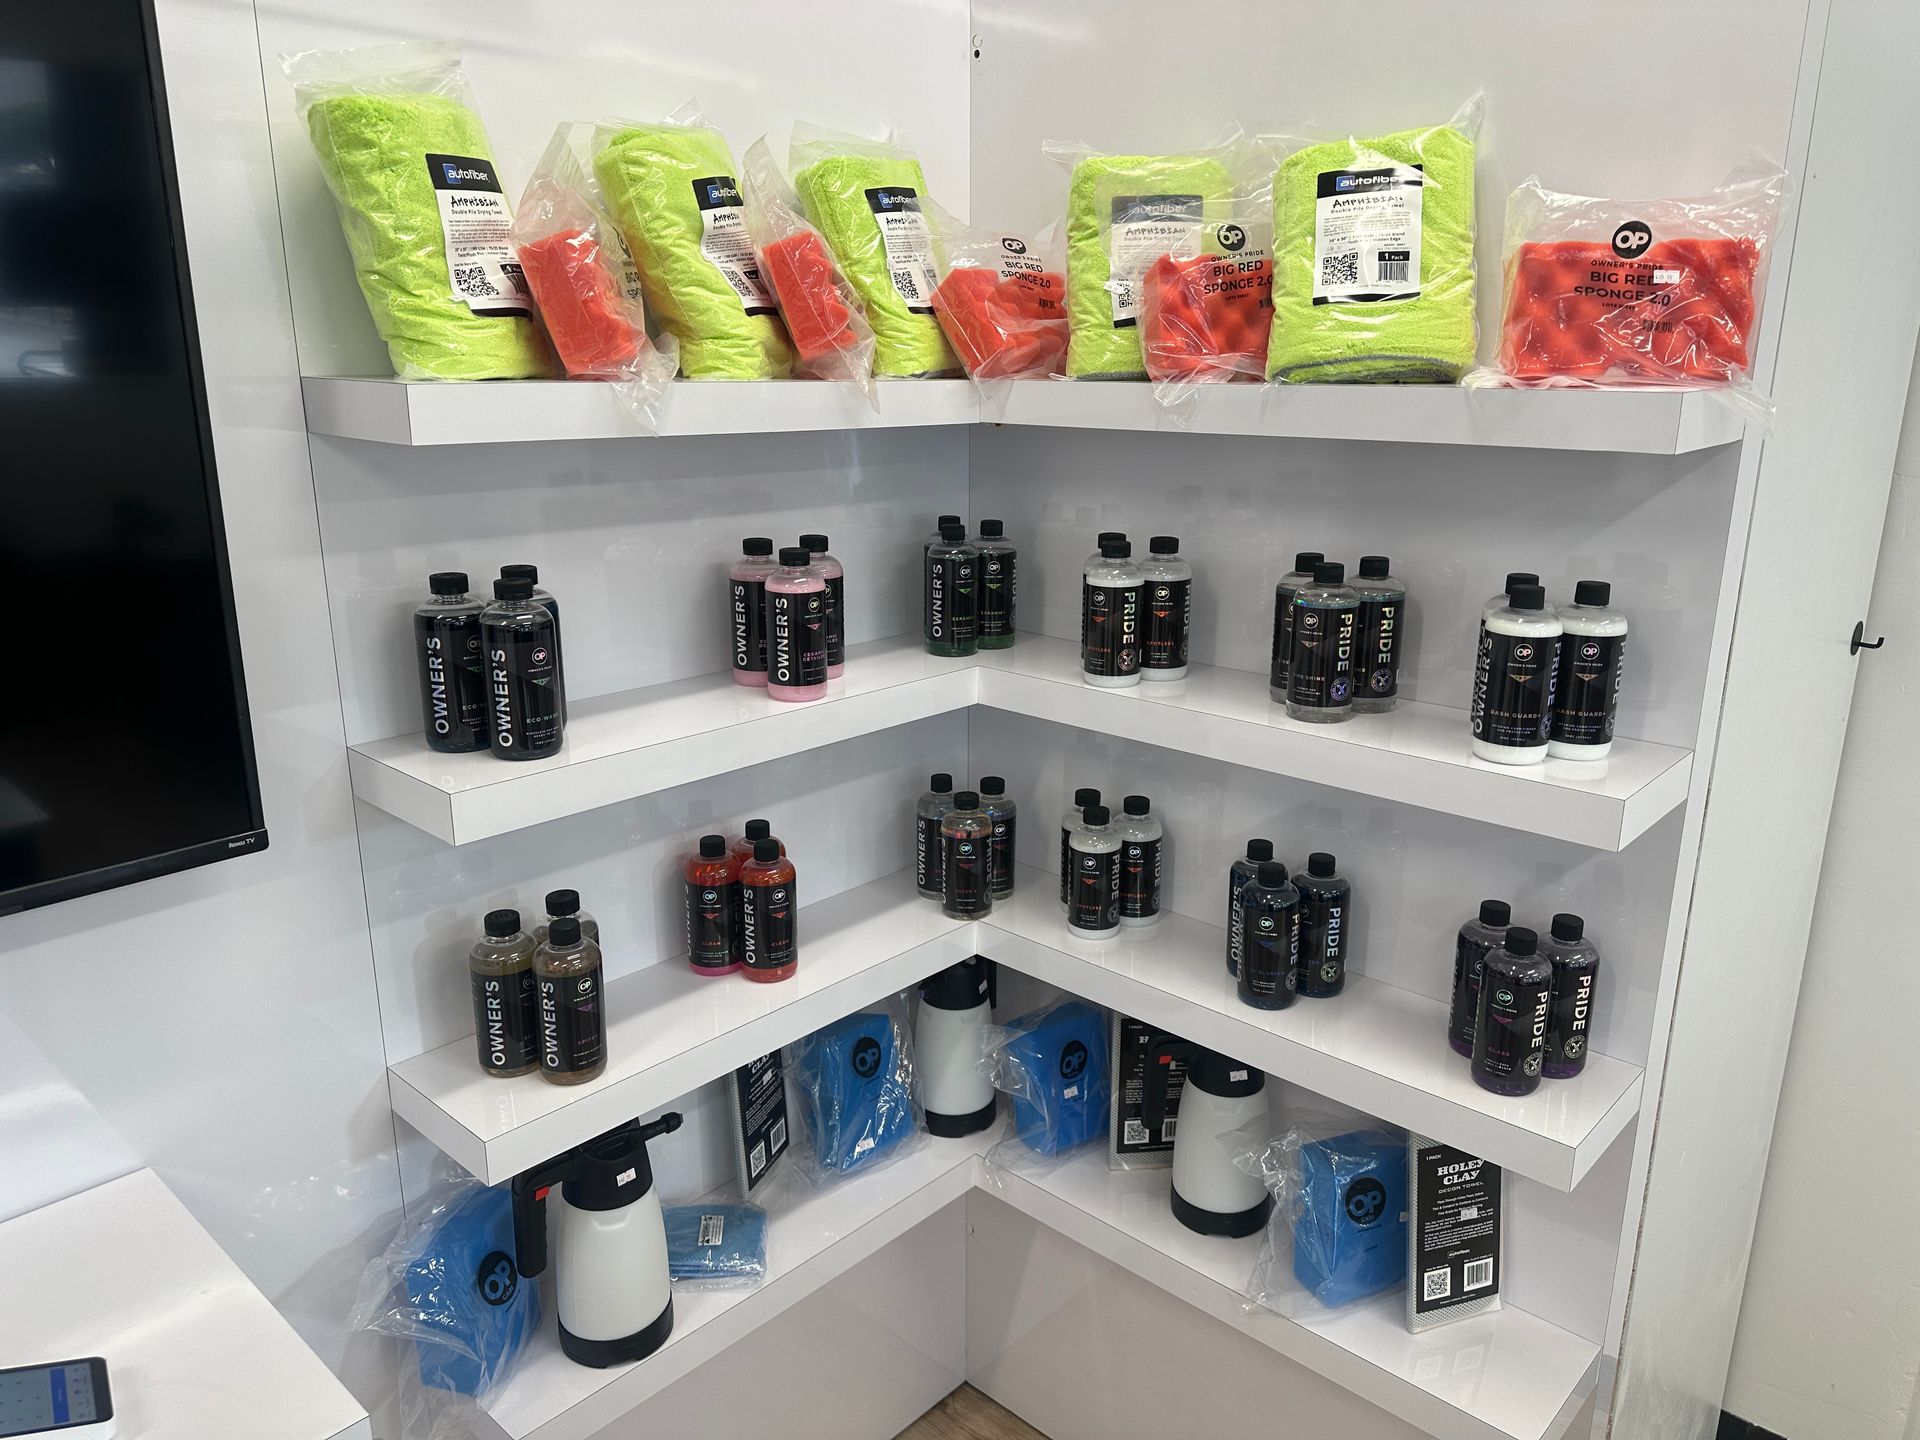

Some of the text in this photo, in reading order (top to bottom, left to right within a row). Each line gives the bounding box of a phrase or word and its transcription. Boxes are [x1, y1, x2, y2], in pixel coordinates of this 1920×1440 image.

[448, 168, 489, 181] autofiber
[450, 195, 499, 208] AMPHIBIAN
[1125, 225, 1186, 236] AMPHIBIAN
[1219, 230, 1243, 245] OP
[1615, 230, 1649, 249] OP
[1004, 240, 1023, 251] OP
[1211, 249, 1265, 262] OWNER'S PRIDE
[1005, 261, 1043, 273] BIG RED
[1213, 260, 1264, 277] BIG RED
[1591, 259, 1633, 269] OWNER'S
[1001, 270, 1051, 289] SPONGE 2.0
[1203, 277, 1254, 295] SPONGE
[1590, 271, 1659, 286] BIG RED
[1574, 286, 1671, 306] SPONGE 2.0
[932, 563, 943, 637] OWNER'S
[1183, 584, 1191, 636] PRIDE
[734, 585, 747, 666] OWNER'S
[1122, 591, 1136, 645] PRIDE
[775, 597, 790, 682] OWNER'S
[1337, 613, 1353, 672] PRIDE
[1378, 606, 1395, 664] PRIDE
[534, 651, 546, 661] OP
[1516, 648, 1530, 657] OP
[1583, 647, 1598, 655] OP
[1547, 641, 1562, 706] PRIDE
[1612, 641, 1626, 704] PRIDE
[426, 636, 450, 734] OWNER'S
[1473, 636, 1493, 734] OWNER'S
[491, 648, 514, 747] OWNER'S
[526, 716, 542, 724] ECO
[1490, 709, 1510, 717] DASH
[228, 840, 246, 848] Roku
[917, 819, 926, 885] OWNER'S
[1111, 854, 1121, 901] PRIDE
[743, 887, 756, 964] OWNER'S
[1230, 886, 1242, 961] OWNER'S
[1326, 907, 1342, 957] PRIDE
[1290, 913, 1300, 965] PRIDE
[580, 981, 592, 990] OP
[1498, 993, 1511, 1001] OP
[1572, 975, 1592, 1031] PRIDE
[485, 980, 506, 1066] OWNER'S
[541, 981, 560, 1068] OWNER'S
[1531, 990, 1549, 1048] PRIDE
[856, 1048, 879, 1071] OP
[1063, 1050, 1085, 1073] OP
[1487, 1046, 1510, 1057] GLASS
[1437, 1158, 1485, 1176] HOLEY
[1442, 1169, 1481, 1186] CLAY
[1438, 1181, 1485, 1194] DECON TOWEL
[1350, 1190, 1381, 1217] OP
[484, 1260, 511, 1300] OP
